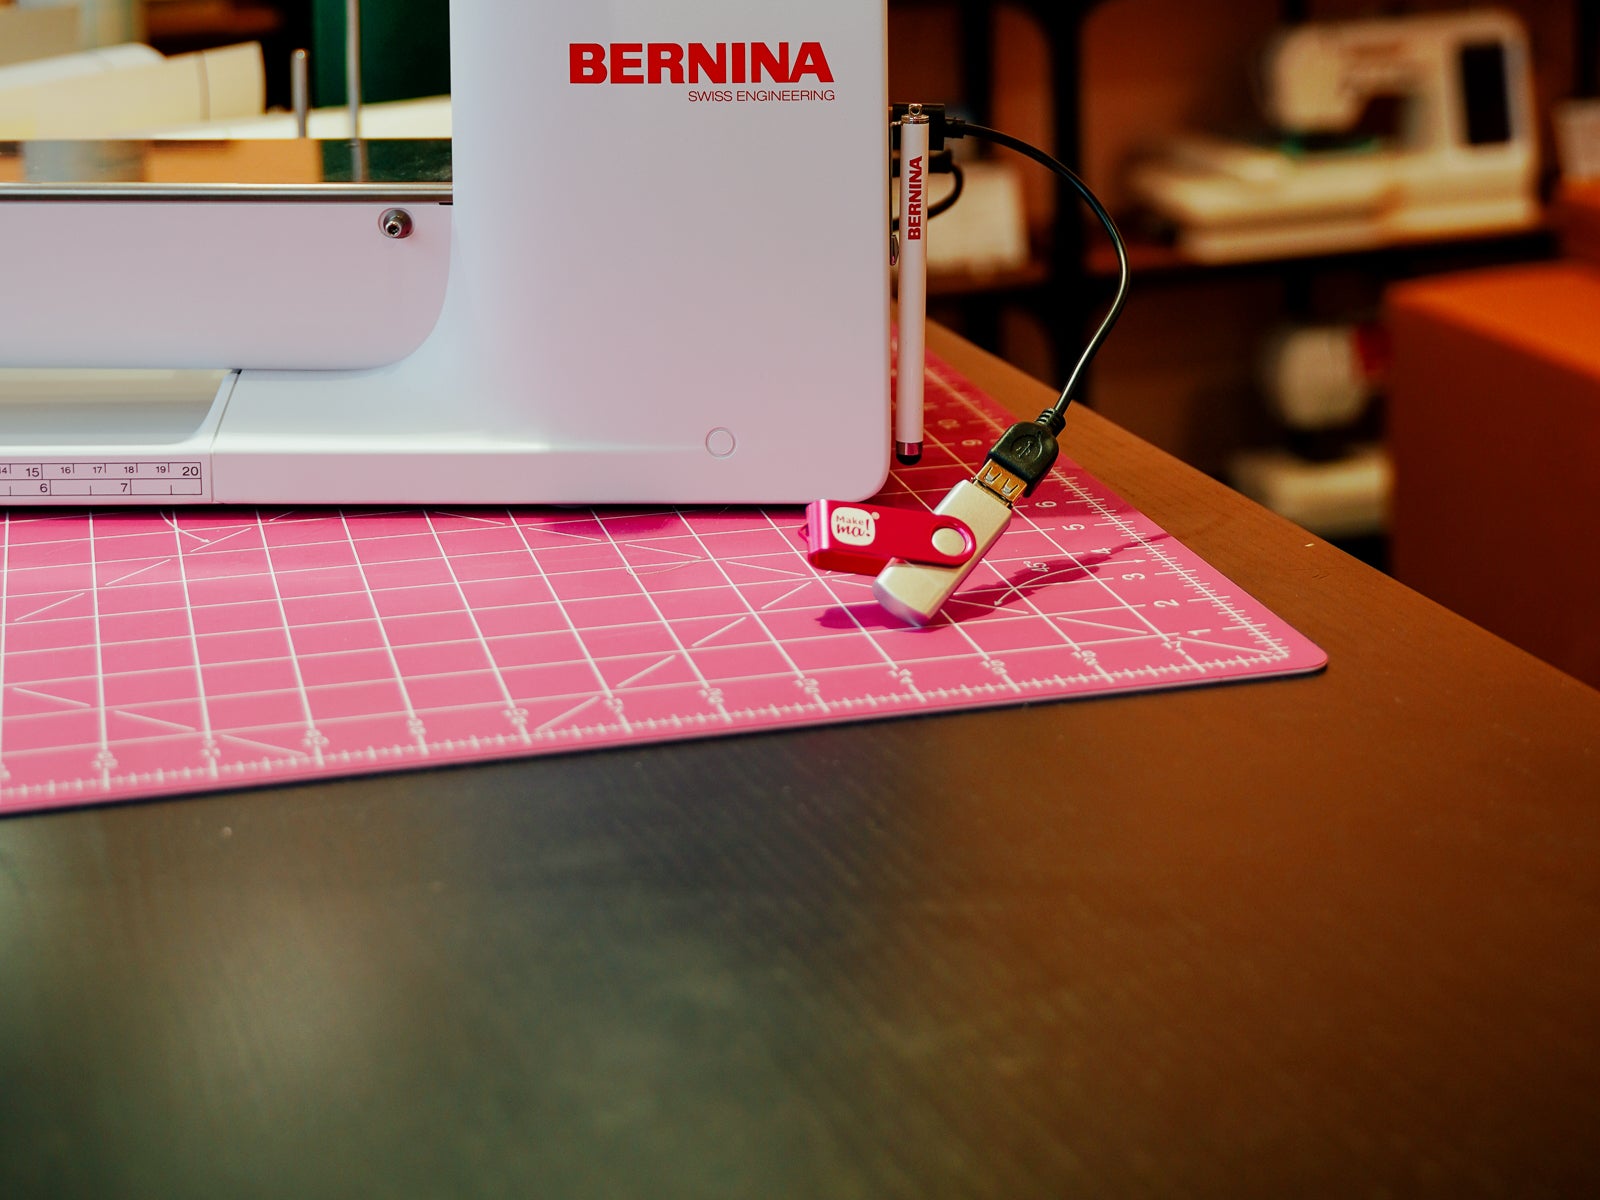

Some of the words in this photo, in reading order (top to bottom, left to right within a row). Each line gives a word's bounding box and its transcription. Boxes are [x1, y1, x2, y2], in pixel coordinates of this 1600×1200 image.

[569, 42, 835, 84] BERNINA
[688, 90, 733, 102] SWISS
[736, 89, 835, 102] ENGINEERING
[907, 155, 923, 241] BERNINA
[25, 467, 40, 478] 15
[60, 466, 72, 474] 16
[92, 466, 103, 474] 17
[124, 466, 135, 474] 18
[155, 466, 167, 474] 19
[182, 466, 199, 476] 20
[39, 483, 48, 493] 6
[120, 483, 129, 493] 7
[836, 514, 864, 525] Make
[1062, 523, 1086, 531] 5
[1090, 547, 1112, 555] 4
[1121, 572, 1146, 581] 3
[1153, 598, 1180, 608] 2
